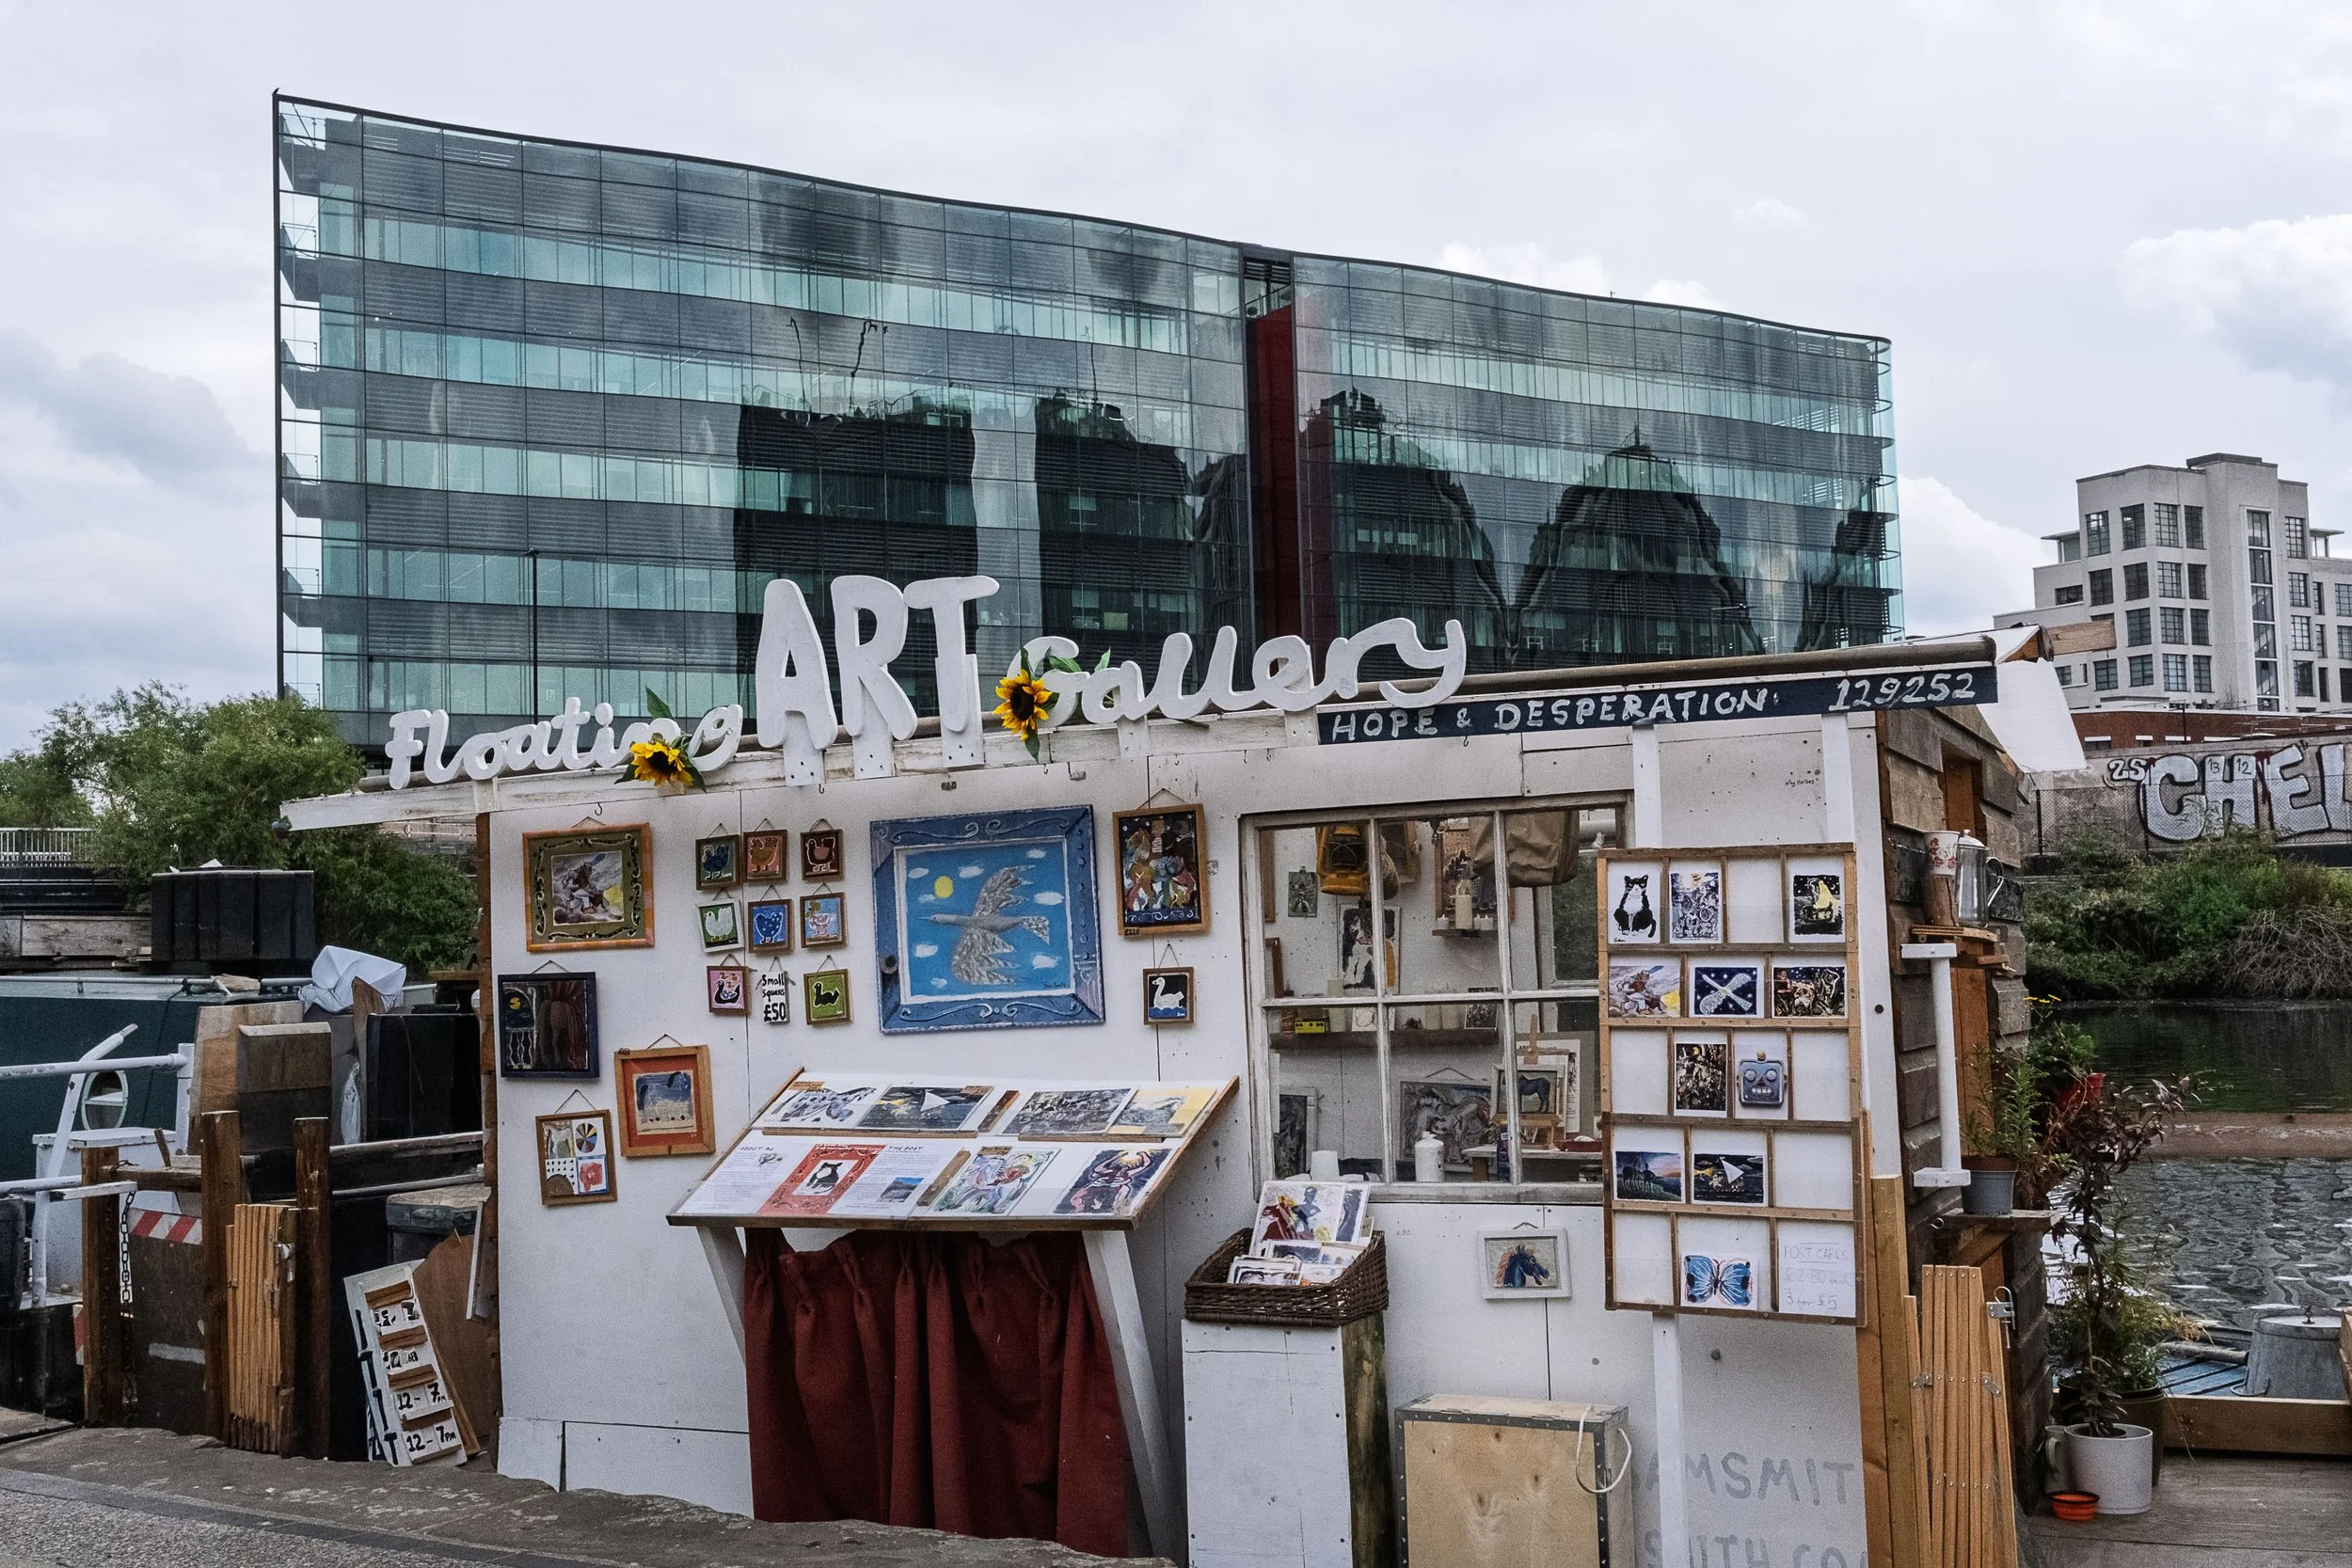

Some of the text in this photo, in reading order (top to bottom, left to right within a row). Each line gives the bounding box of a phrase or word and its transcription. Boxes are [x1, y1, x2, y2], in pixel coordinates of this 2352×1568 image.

[385, 575, 1466, 791] Floating ART Gallery
[1332, 672, 1977, 741] HOPE & DESPERATION 129252
[762, 973, 786, 987] Small
[763, 1002, 787, 1022] £50
